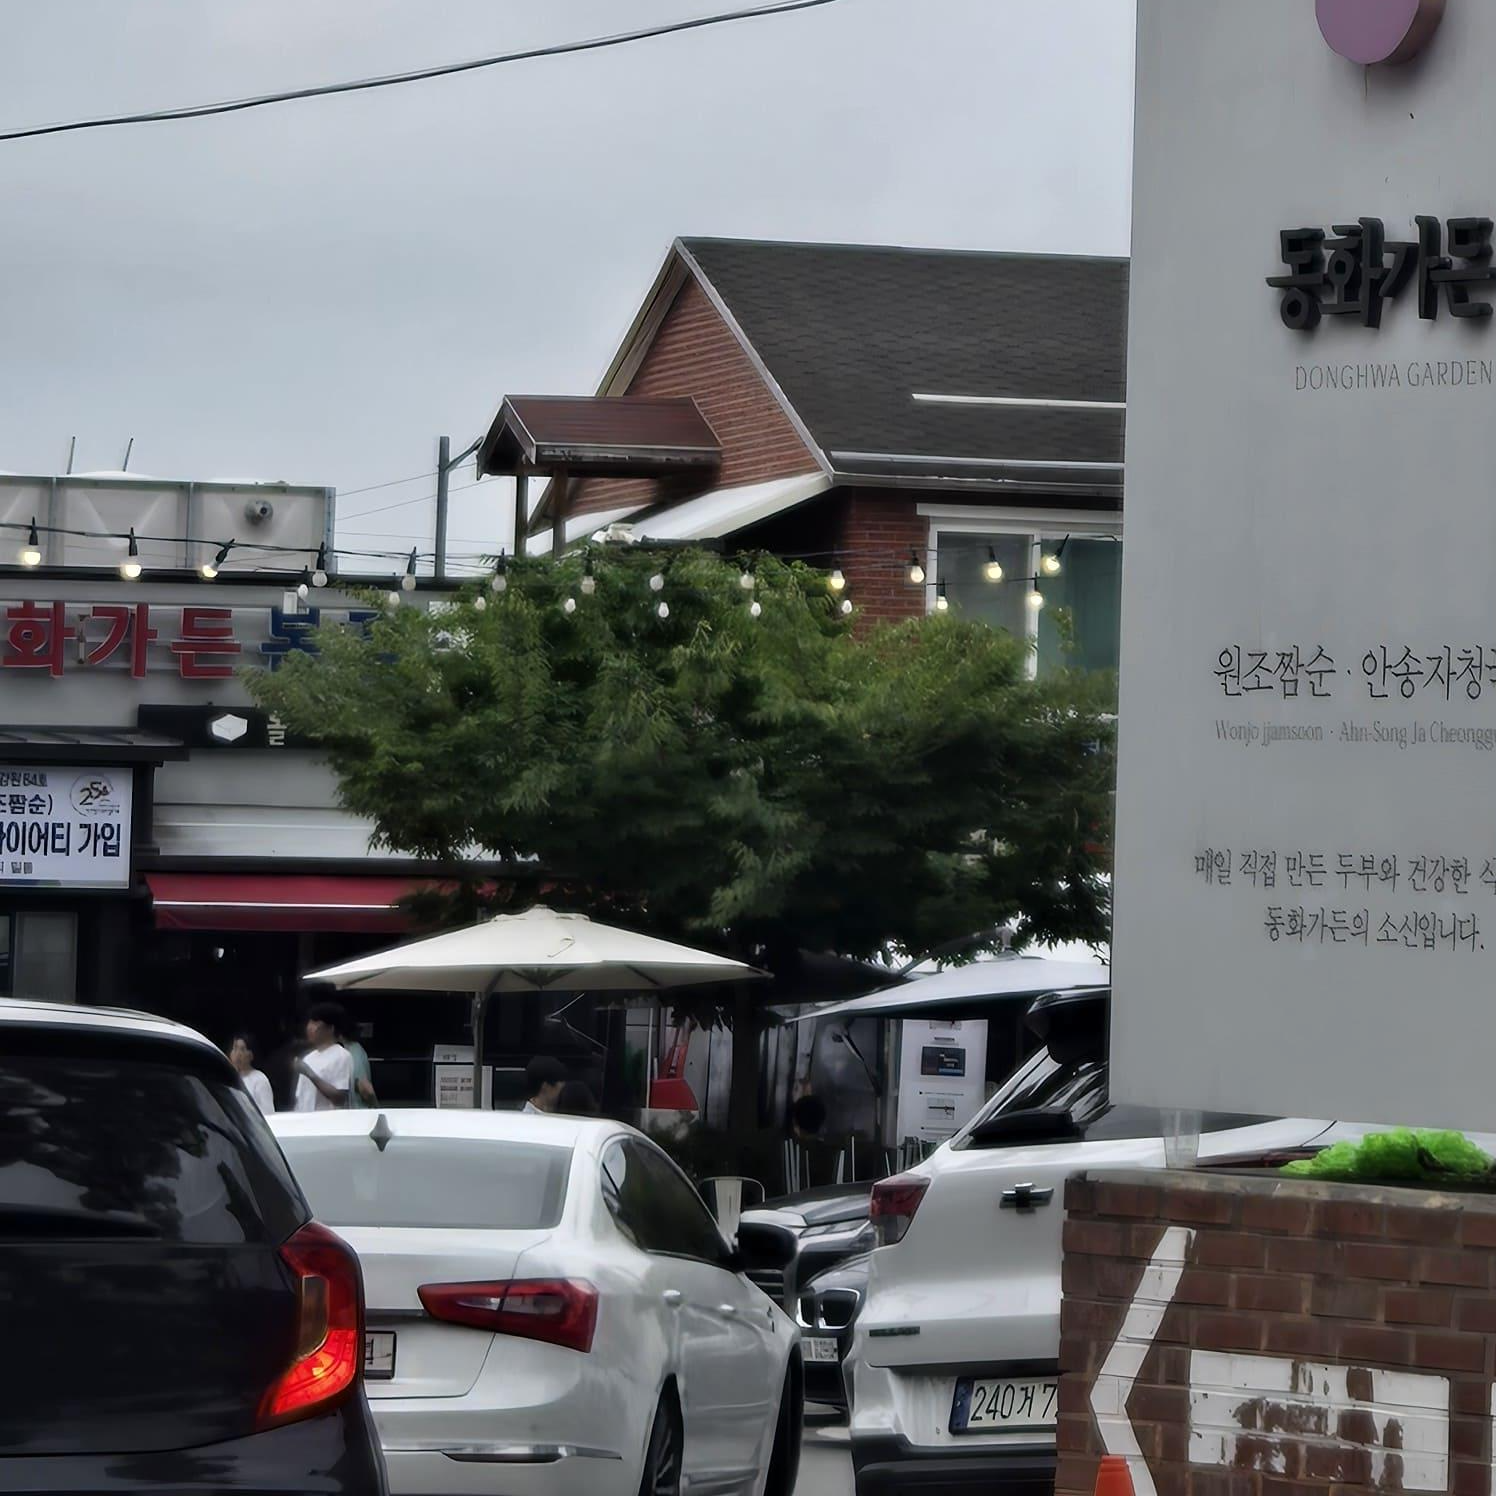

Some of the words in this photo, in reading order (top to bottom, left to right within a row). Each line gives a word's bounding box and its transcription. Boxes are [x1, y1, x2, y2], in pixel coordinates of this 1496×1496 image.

[1295, 365, 1400, 390] DONGHWA
[1407, 360, 1493, 386] GARDEN
[2, 602, 241, 679] 화가든
[1214, 644, 1336, 700] 원조짬순
[78, 822, 121, 858] 가입
[1195, 848, 1232, 887] 매일
[1240, 849, 1277, 888] 직접
[1286, 851, 1327, 887] 만든
[1335, 854, 1400, 893] 두부와
[1407, 855, 1471, 894] 건강한
[1264, 906, 1369, 947] 동화가든의
[1376, 912, 1485, 953] 소신입니다.
